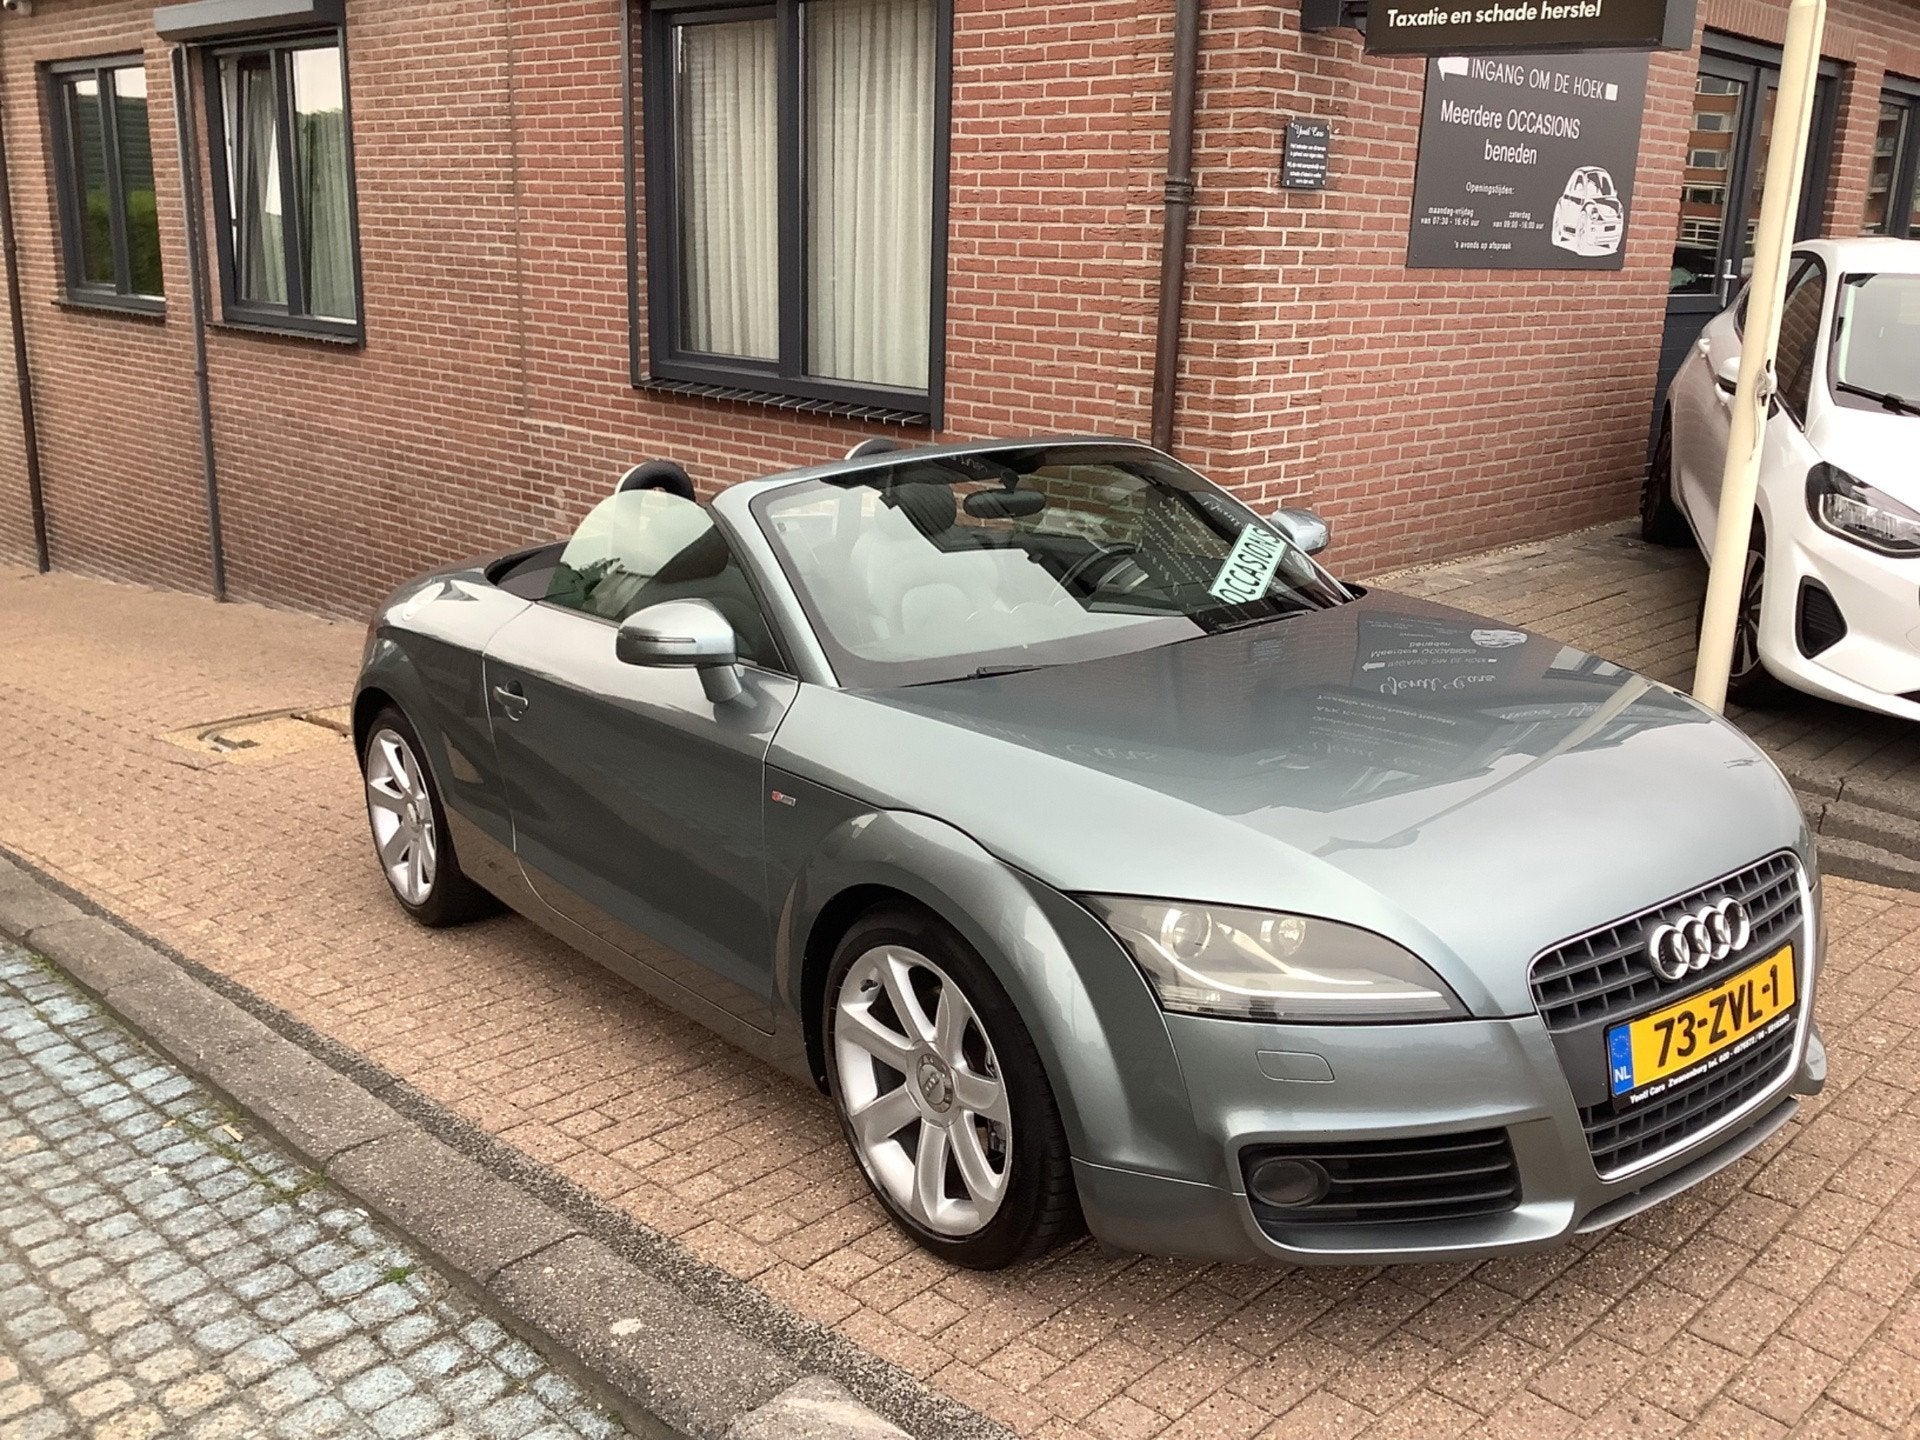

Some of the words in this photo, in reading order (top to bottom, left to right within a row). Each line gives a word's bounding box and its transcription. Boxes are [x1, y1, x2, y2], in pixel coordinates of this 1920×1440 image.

[1387, 9, 1448, 27] Taxatie
[1450, 10, 1471, 24] en
[1475, 4, 1537, 23] schade
[1540, 0, 1601, 19] herstel
[1471, 58, 1525, 86] INGANG
[1529, 68, 1550, 90] OM
[1554, 73, 1570, 94] DE
[1573, 79, 1605, 100] HOEK
[1440, 100, 1502, 129] Meerdere
[1507, 109, 1581, 139] OCCASIONS
[1484, 139, 1538, 165] beneden
[1219, 527, 1280, 604] OCCASIONS
[1654, 964, 1779, 1068] 73-ZVL-1
[1614, 1066, 1631, 1083] NL
